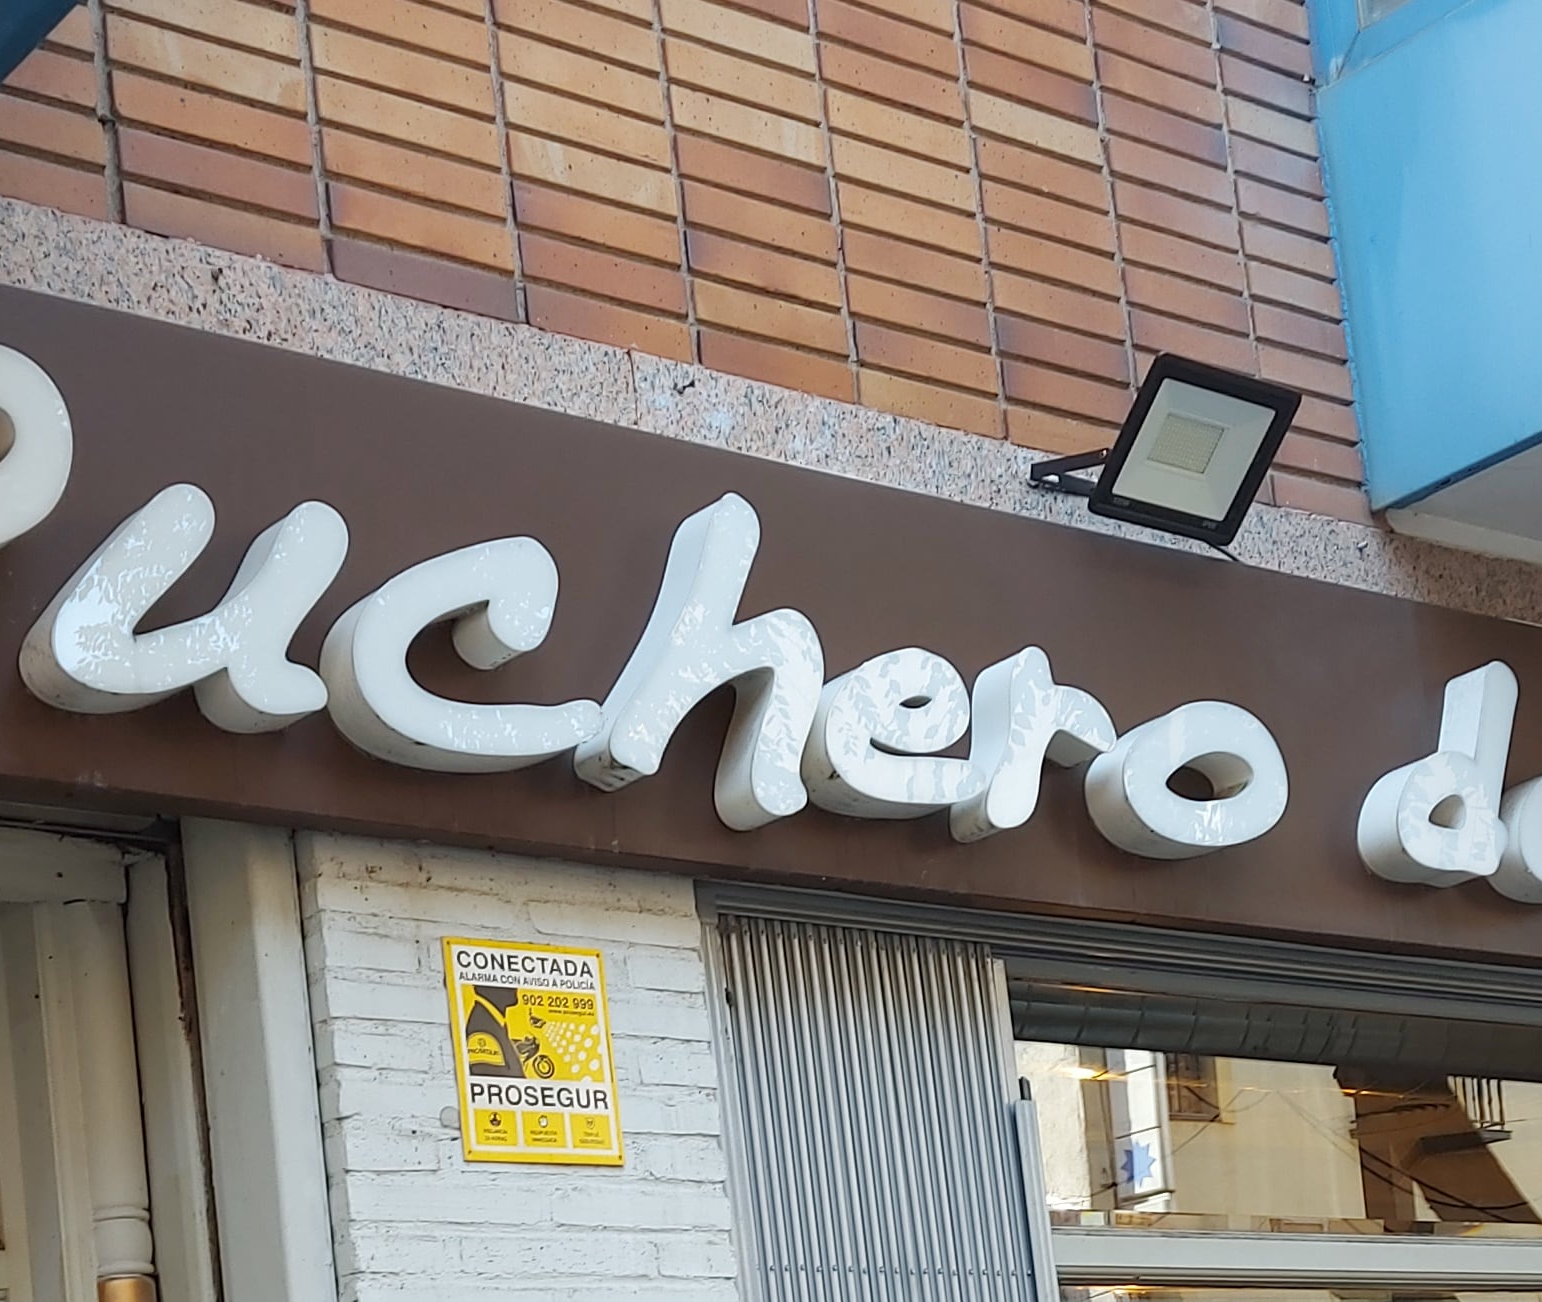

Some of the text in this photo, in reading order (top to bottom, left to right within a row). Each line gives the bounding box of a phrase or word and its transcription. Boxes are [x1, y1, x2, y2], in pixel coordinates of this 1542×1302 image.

[456, 950, 595, 978] CONECTADA
[458, 972, 595, 991] ALARMA CON AVISO A POLICÍA
[522, 994, 594, 1010] 902 202 999
[470, 1082, 609, 1110] PROSEGUR
